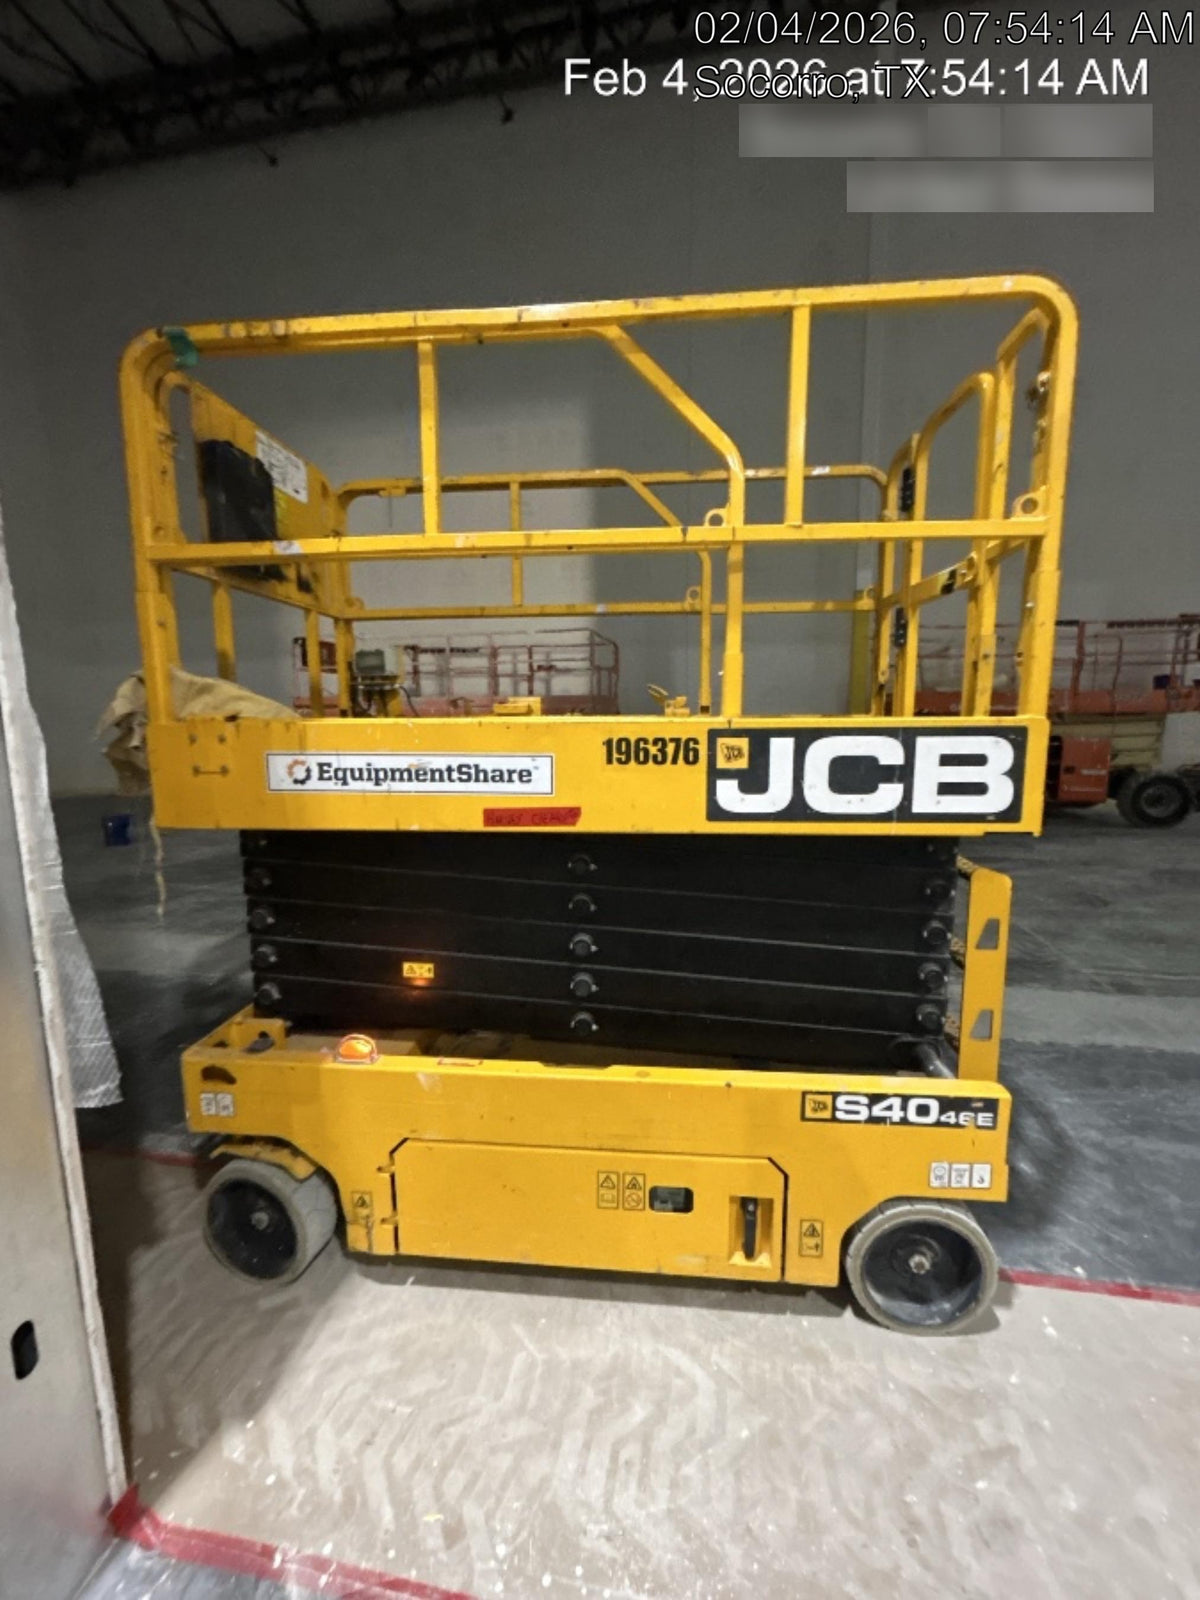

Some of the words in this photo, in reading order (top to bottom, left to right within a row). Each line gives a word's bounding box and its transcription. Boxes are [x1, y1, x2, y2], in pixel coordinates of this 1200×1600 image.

[602, 737, 700, 767] 196376
[316, 761, 533, 786] EquipmentShare
[715, 735, 1015, 815] JCB
